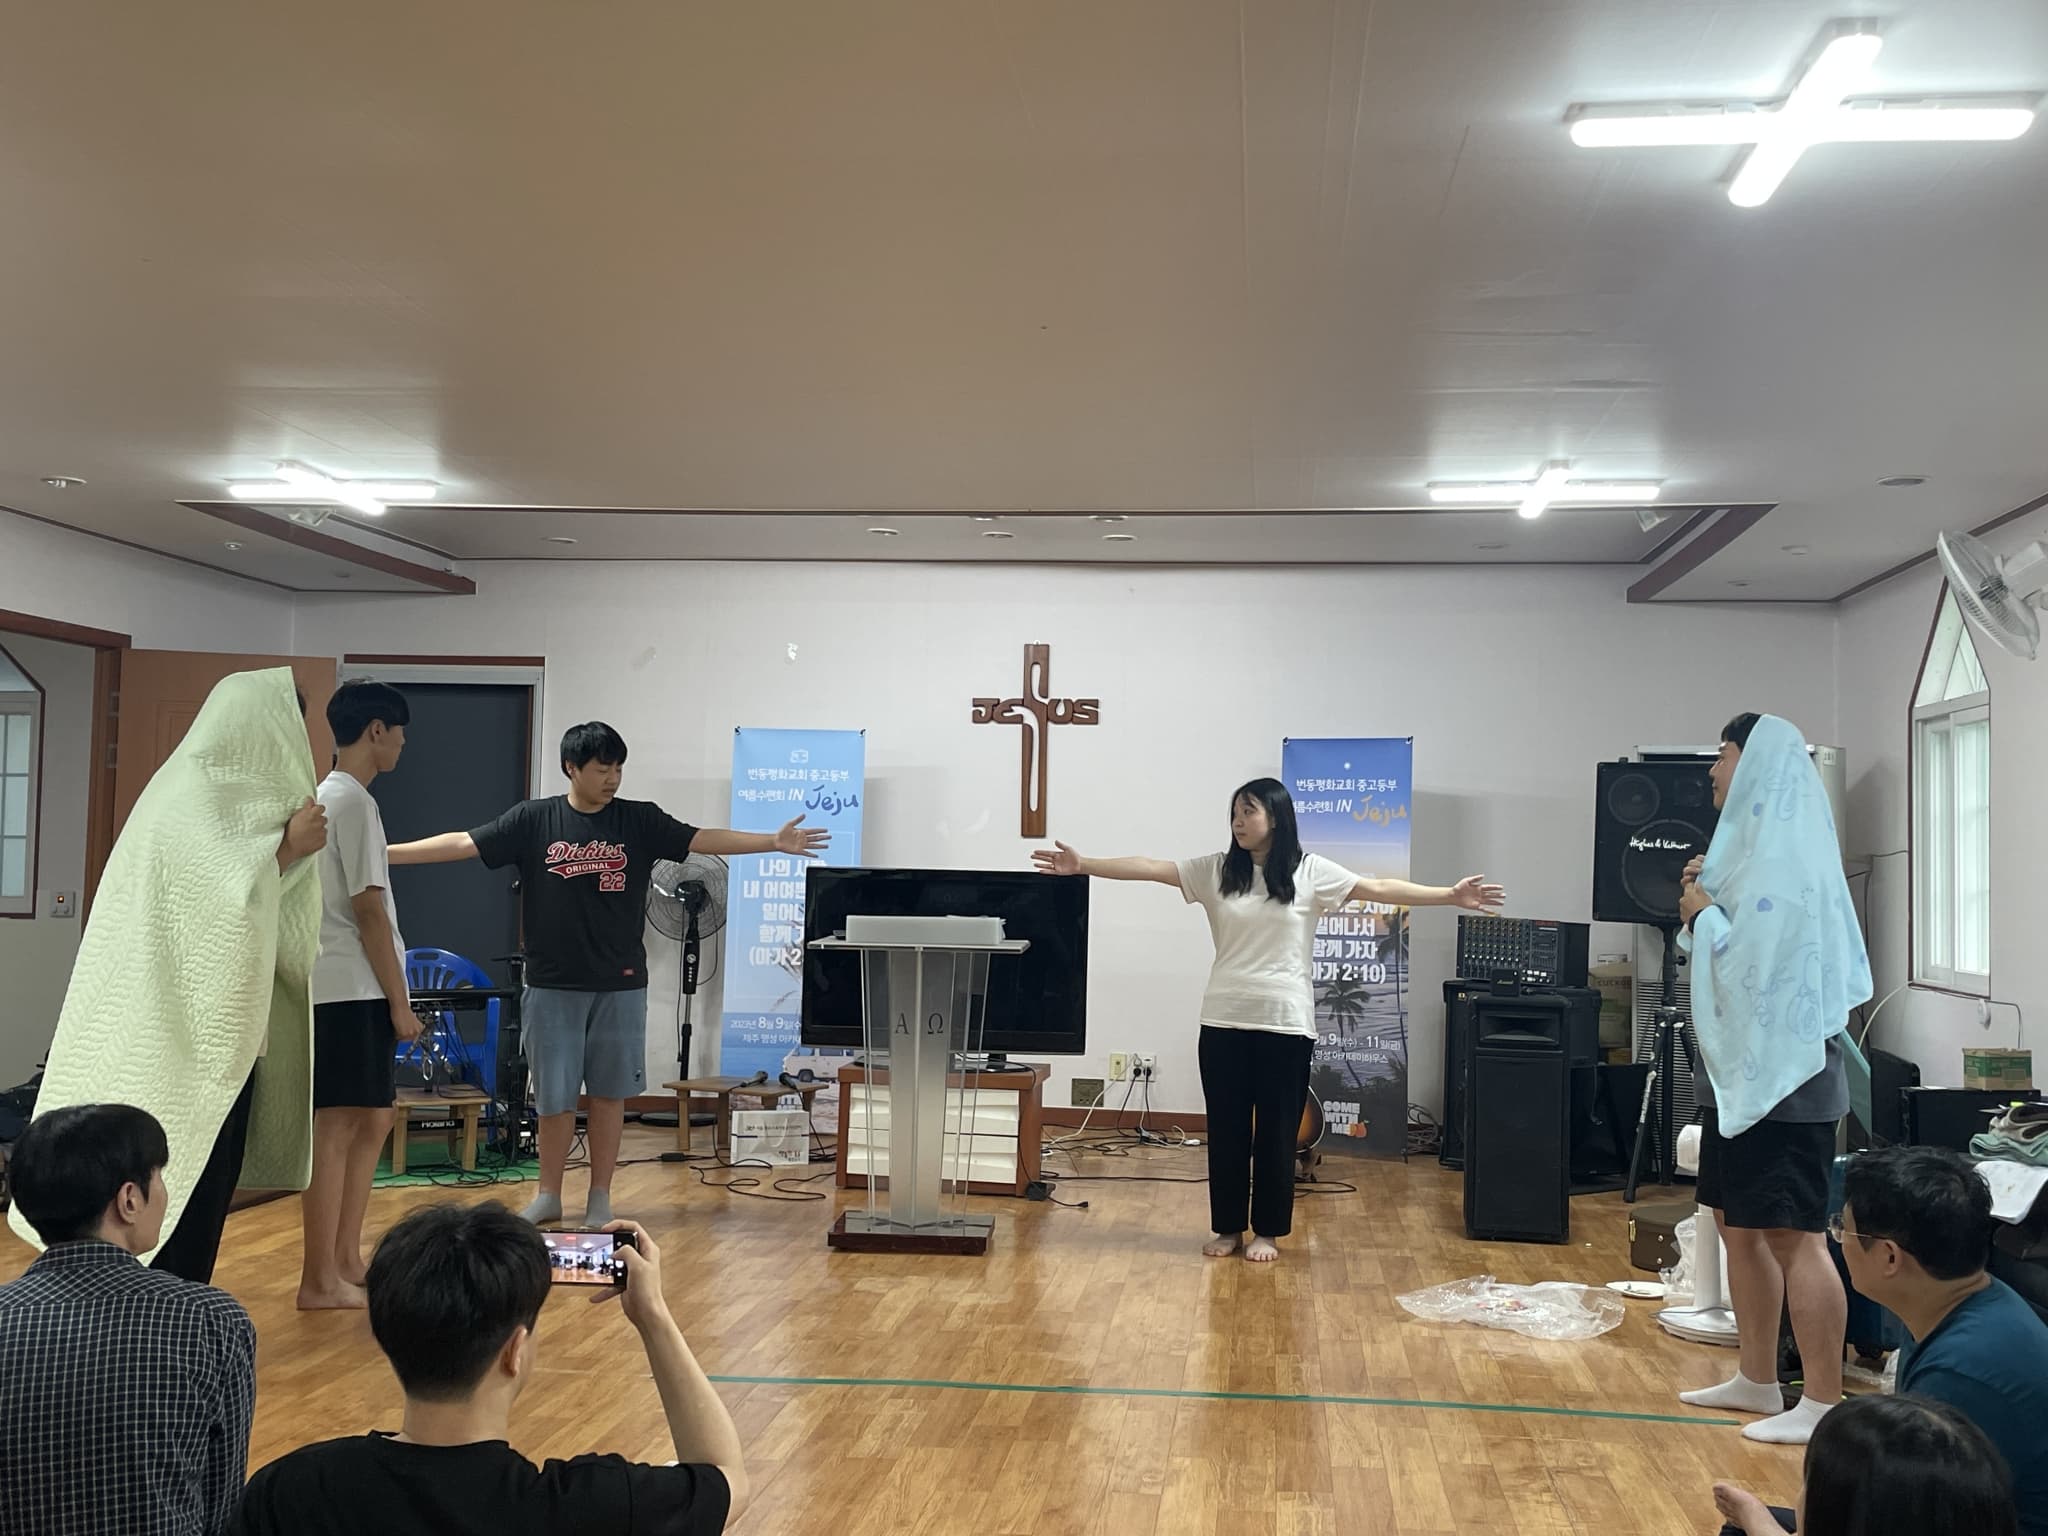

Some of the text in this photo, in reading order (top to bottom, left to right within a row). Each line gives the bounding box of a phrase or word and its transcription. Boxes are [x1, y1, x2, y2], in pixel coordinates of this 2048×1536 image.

[747, 768, 849, 781] 번동평화교회 중고등부
[1296, 779, 1397, 792] 번동평화교회 중고등부
[738, 784, 859, 816] 여름수련회 IN Jeju
[1336, 799, 1352, 813] IN
[1353, 794, 1407, 828] Jeju
[545, 840, 625, 864] Dickies
[565, 861, 611, 875] ORIGINAL
[760, 859, 790, 877] 나의
[599, 871, 627, 892] 22
[743, 880, 760, 898] 내
[1312, 938, 1379, 960] 함께 가자
[1341, 962, 1387, 985] 2:10)
[927, 1012, 944, 1035] Ω
[1323, 1100, 1361, 1114] COME
[1324, 1111, 1359, 1124] WITH
